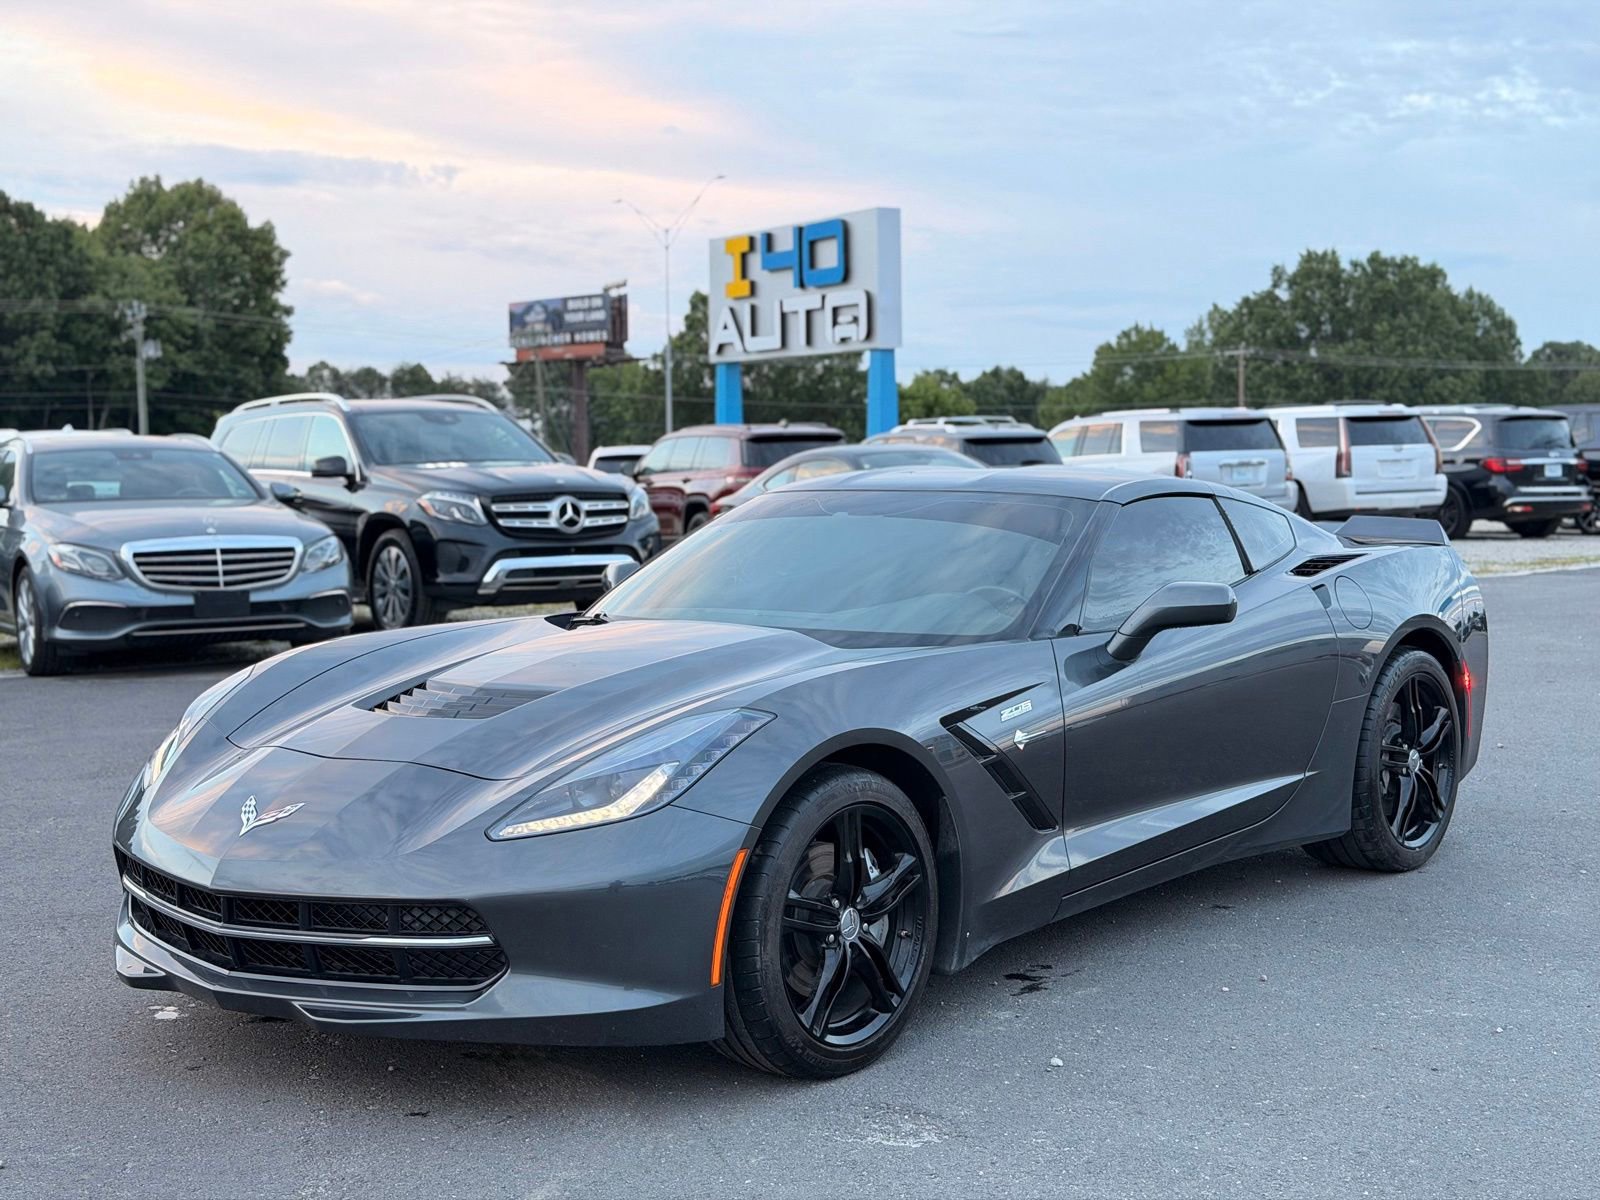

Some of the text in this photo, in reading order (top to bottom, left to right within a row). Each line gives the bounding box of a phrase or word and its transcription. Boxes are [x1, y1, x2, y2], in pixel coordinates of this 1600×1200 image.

[725, 218, 847, 299] I 40
[709, 289, 870, 355] AUTO
